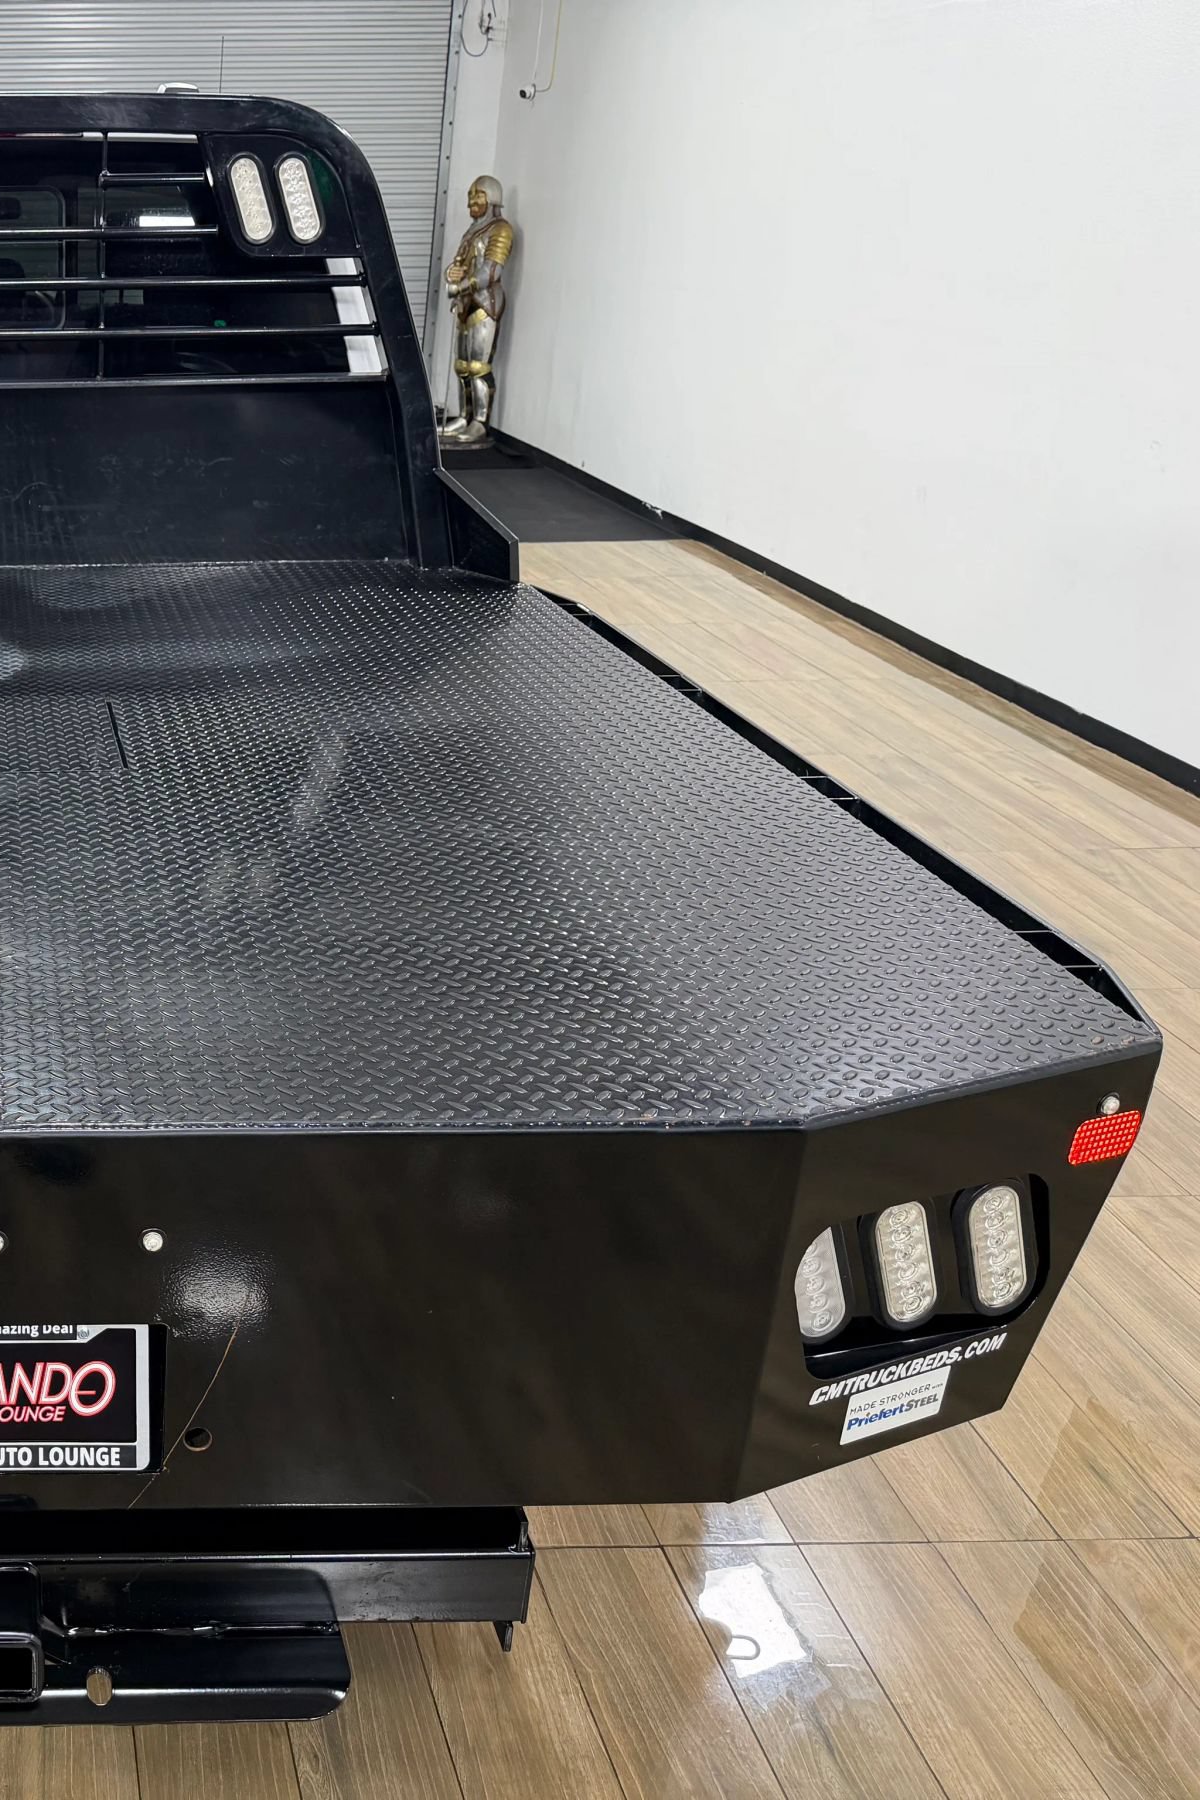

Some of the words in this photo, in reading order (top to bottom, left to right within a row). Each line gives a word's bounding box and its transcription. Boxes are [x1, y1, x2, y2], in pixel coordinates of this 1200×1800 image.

[808, 1332, 1008, 1406] CMTRUCKBEDS.COM
[850, 1400, 877, 1416] MADE
[879, 1383, 930, 1406] STRONGER
[38, 1446, 121, 1467] LOUNGE
